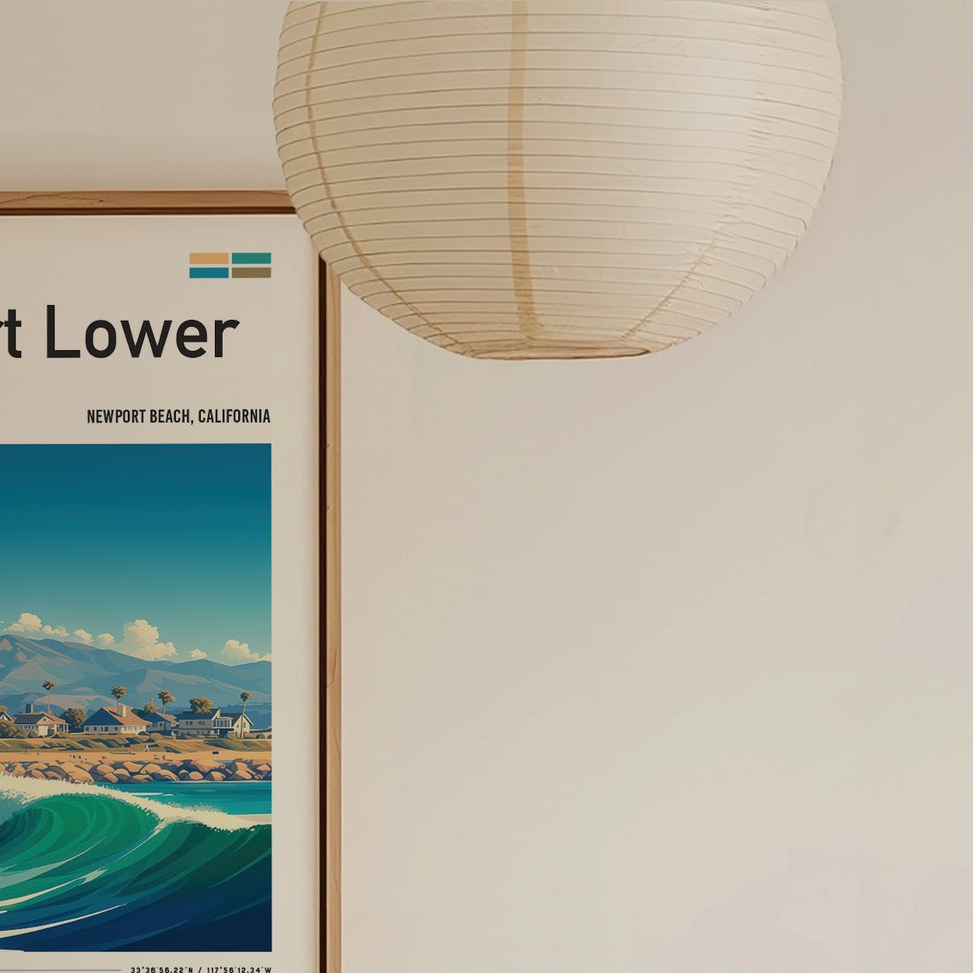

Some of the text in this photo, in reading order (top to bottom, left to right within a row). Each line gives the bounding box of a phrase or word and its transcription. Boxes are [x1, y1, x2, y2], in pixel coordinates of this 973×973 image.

[46, 304, 240, 359] Lower
[87, 409, 271, 427] NEWPORT BEACH, CALIFORNIA
